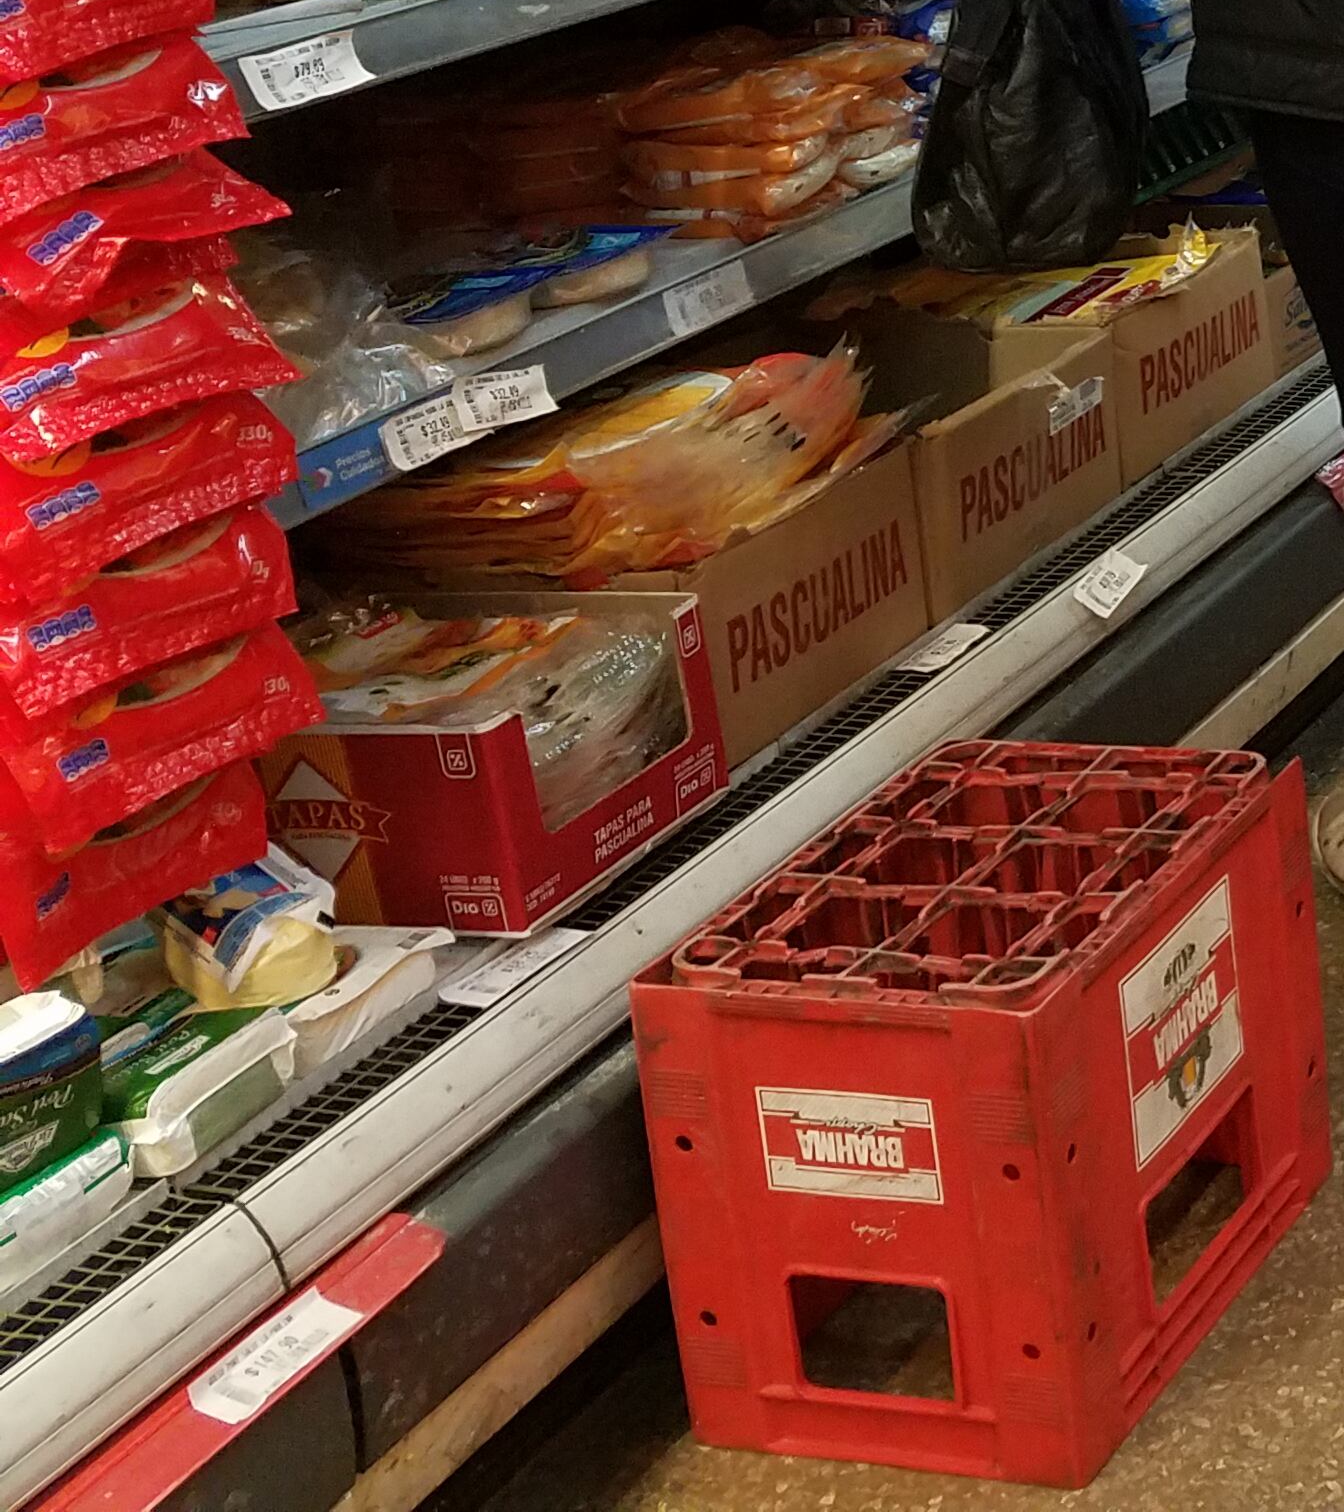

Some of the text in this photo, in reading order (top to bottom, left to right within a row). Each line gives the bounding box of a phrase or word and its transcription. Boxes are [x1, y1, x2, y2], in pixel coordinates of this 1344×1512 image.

[1140, 288, 1260, 414] PASCUALINA
[960, 409, 1107, 542] PASCUALINA
[726, 519, 907, 692] PASCUALINA
[594, 797, 652, 844] TAPAS PARA
[594, 814, 655, 864] PASCUALINA
[452, 901, 478, 914] Dia
[1153, 971, 1218, 1070] BRAHMA
[796, 1129, 904, 1168] BRAHMA
